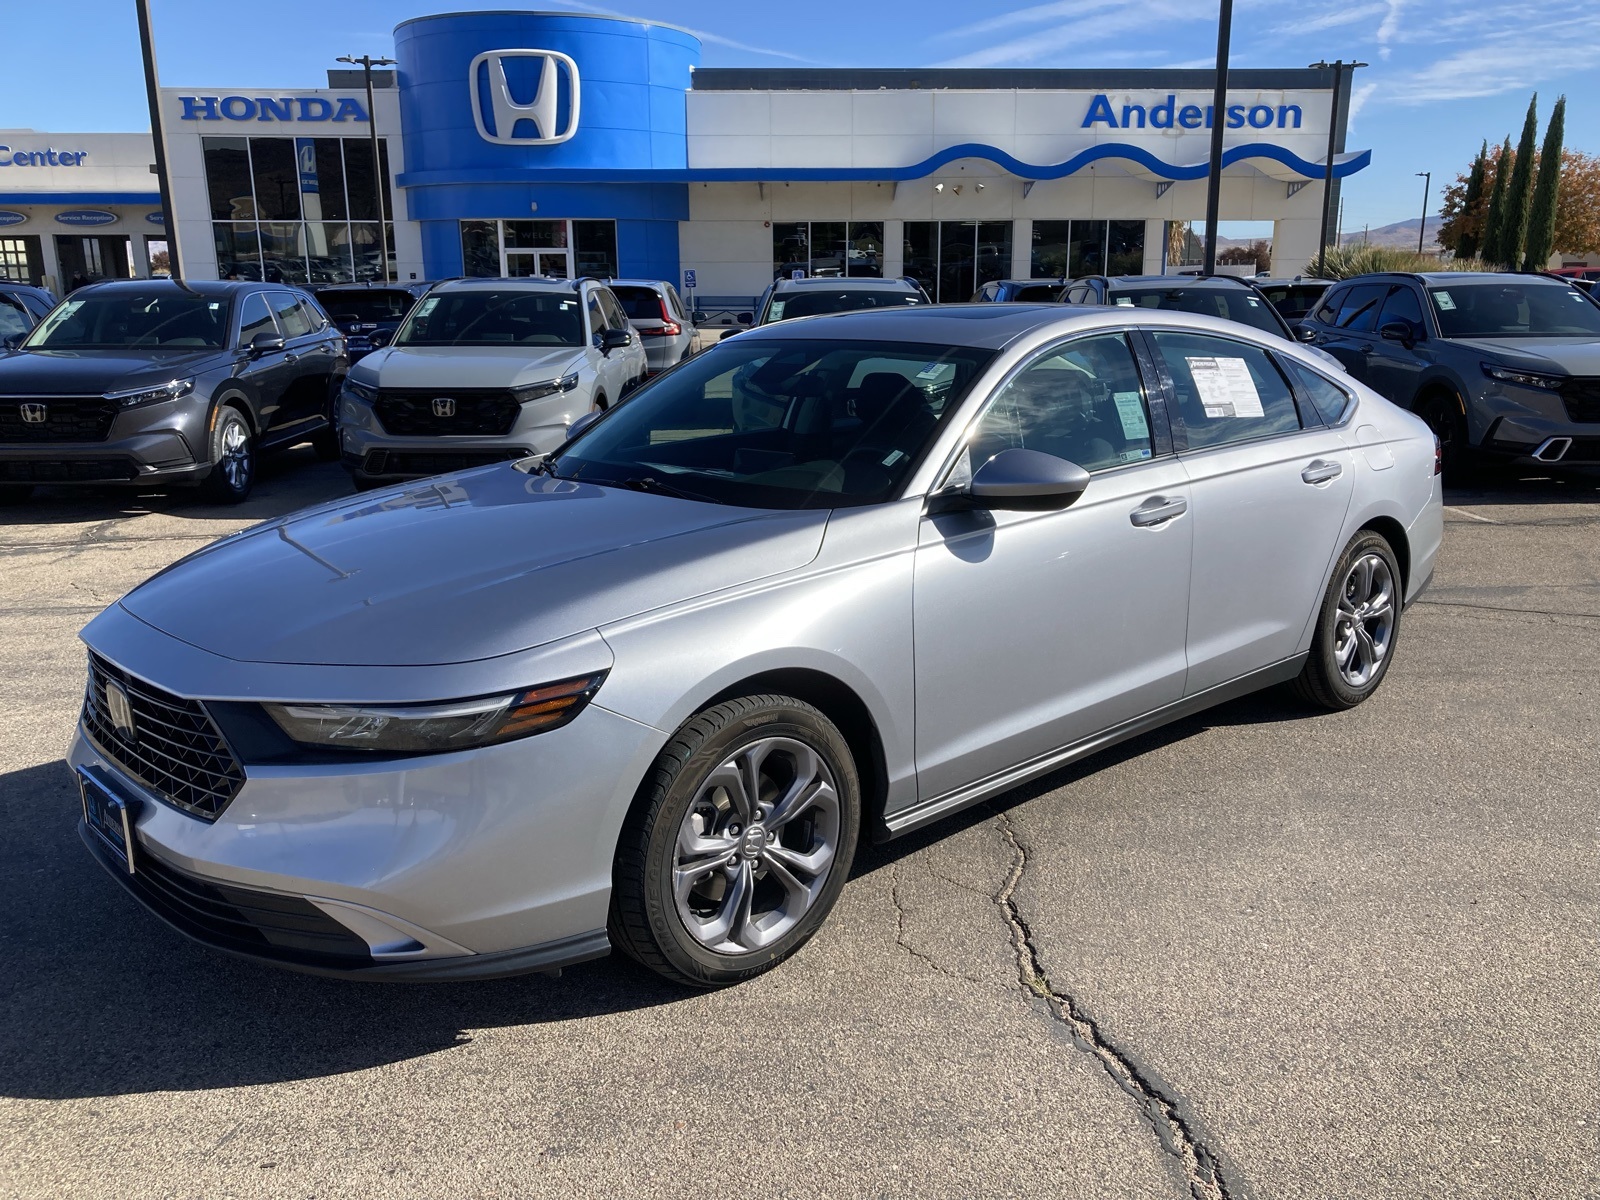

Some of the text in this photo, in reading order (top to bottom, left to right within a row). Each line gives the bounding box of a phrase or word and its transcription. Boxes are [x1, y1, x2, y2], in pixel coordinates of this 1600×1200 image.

[178, 96, 370, 121] HONDA
[1081, 94, 1303, 128] Anderson
[0, 145, 88, 167] Center
